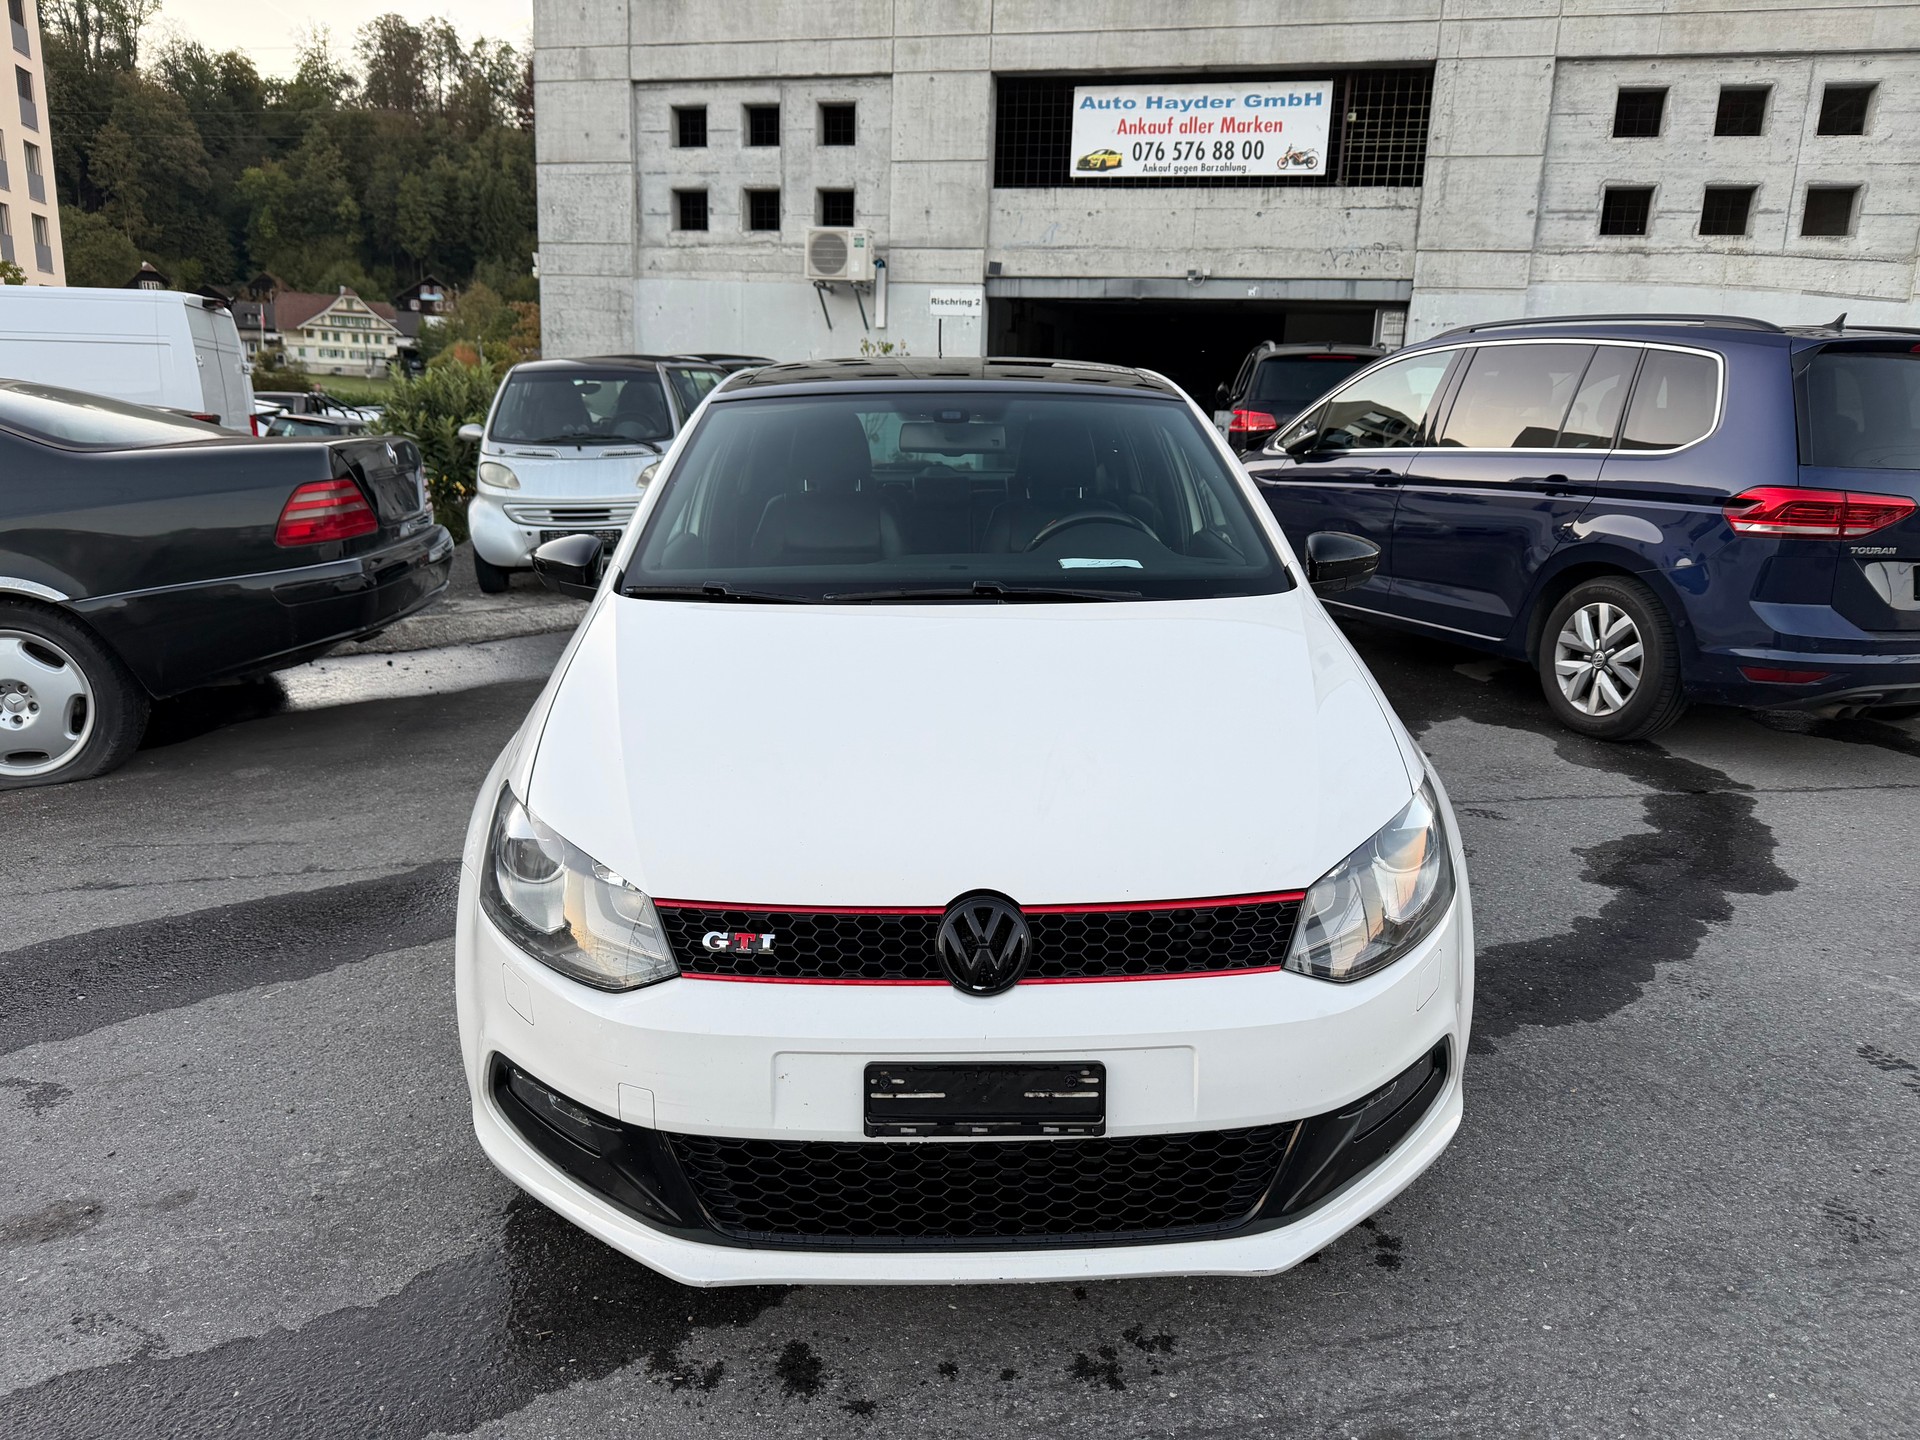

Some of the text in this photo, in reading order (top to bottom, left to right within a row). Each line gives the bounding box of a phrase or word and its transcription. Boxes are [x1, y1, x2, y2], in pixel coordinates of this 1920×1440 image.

[1080, 92, 1323, 112] Auto Hayder GmbH
[1117, 115, 1283, 135] Ankauf aller Marken
[1132, 140, 1265, 161] 076 576 88 00
[1142, 163, 1247, 174] Ankauf gegen Barzahlung
[931, 298, 981, 307] Rischring 2
[1849, 546, 1898, 555] TOURAN
[701, 931, 776, 955] GTI
